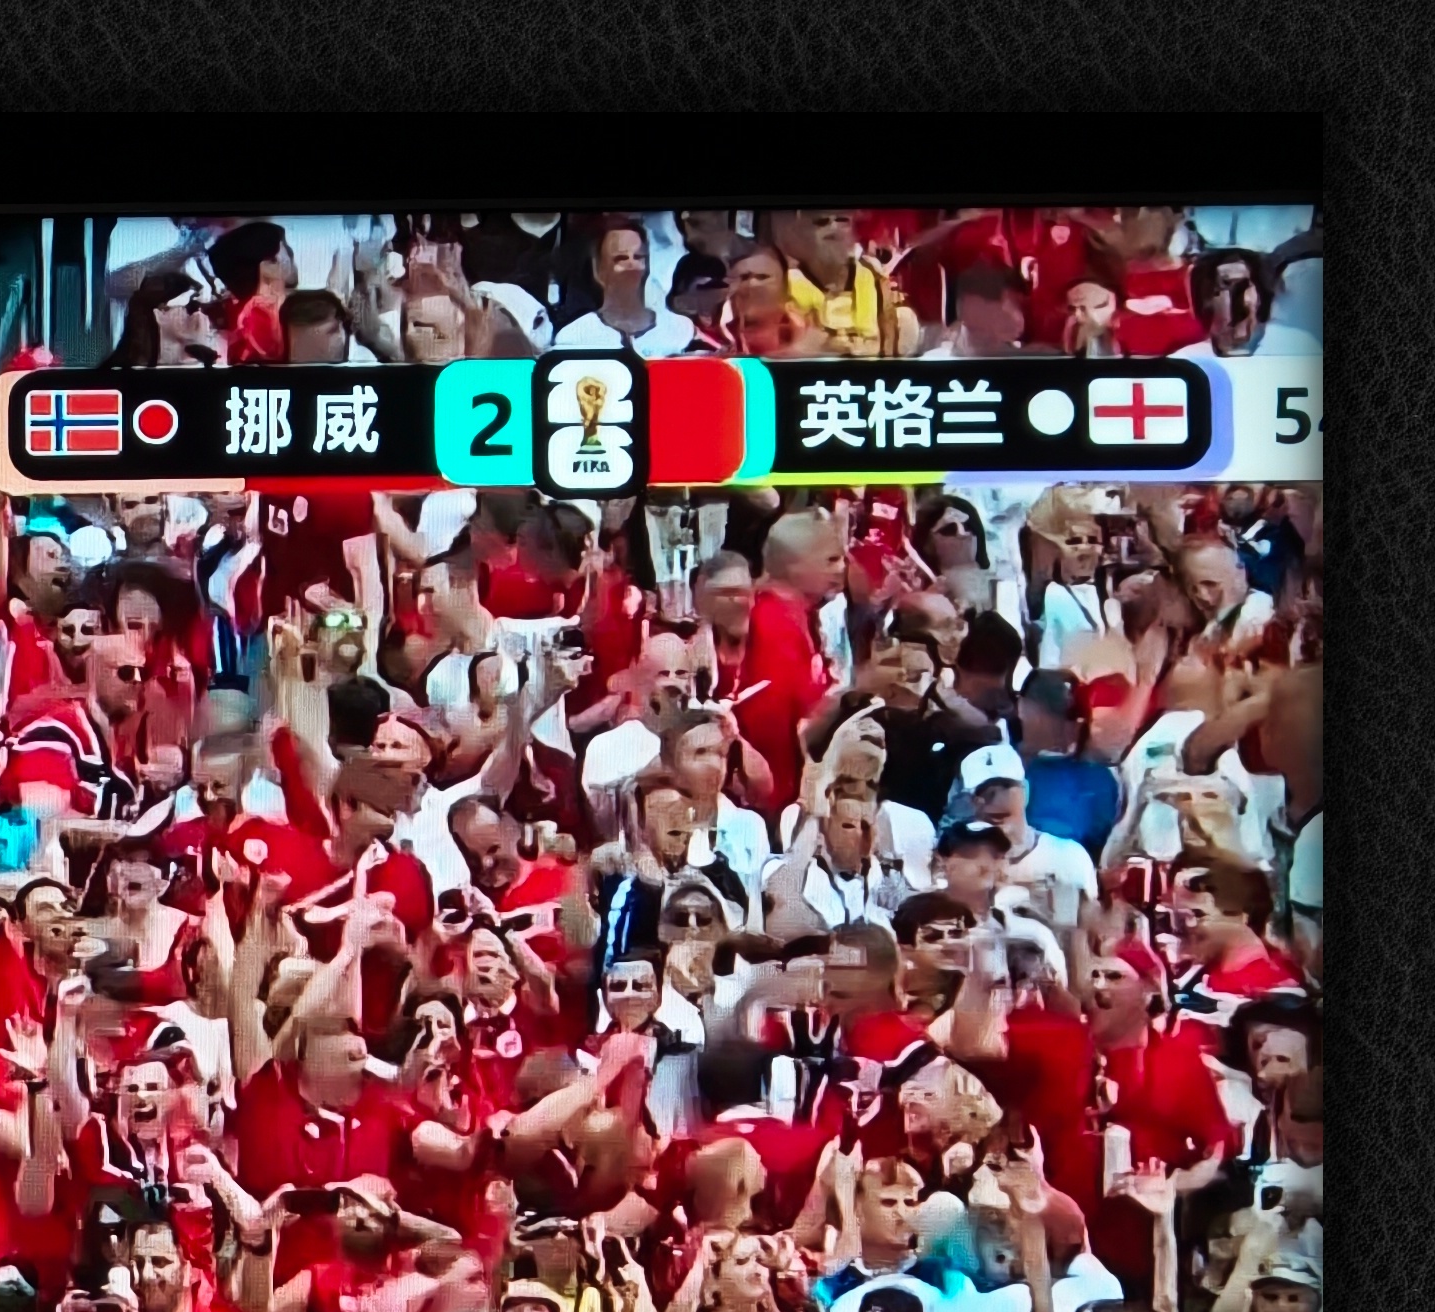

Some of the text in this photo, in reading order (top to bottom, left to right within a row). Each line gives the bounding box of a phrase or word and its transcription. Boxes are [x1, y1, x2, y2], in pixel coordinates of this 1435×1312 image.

[225, 384, 380, 456] 挪威
[469, 392, 513, 456] 2
[798, 379, 1005, 449] 英格兰
[1274, 386, 1323, 444] 5
